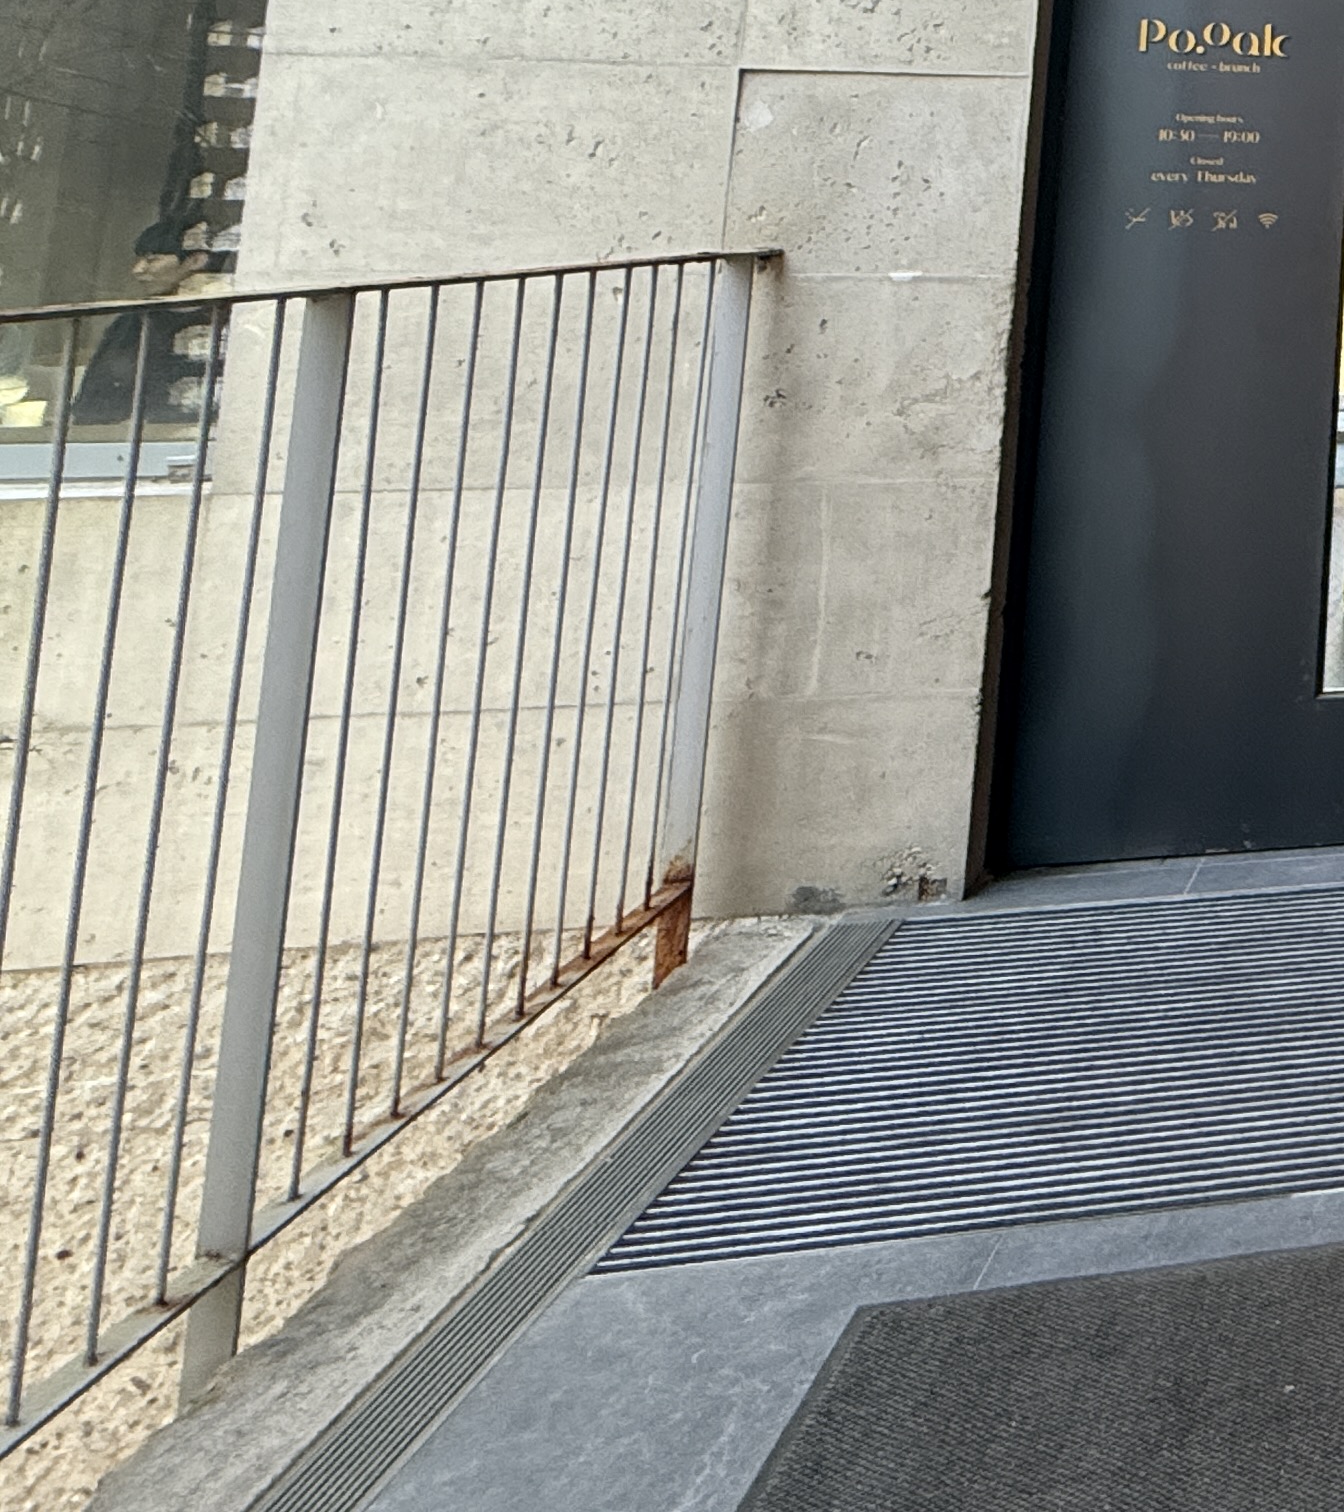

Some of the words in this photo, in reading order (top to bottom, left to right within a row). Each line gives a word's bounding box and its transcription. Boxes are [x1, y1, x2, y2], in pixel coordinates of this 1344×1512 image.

[1167, 61, 1209, 71] coffee
[1218, 61, 1261, 73] brunch
[1175, 113, 1216, 124] Opening
[1223, 130, 1261, 144] 19:00
[1190, 156, 1224, 166] Closed
[1151, 171, 1188, 184] every
[1197, 169, 1257, 184] Thursday
